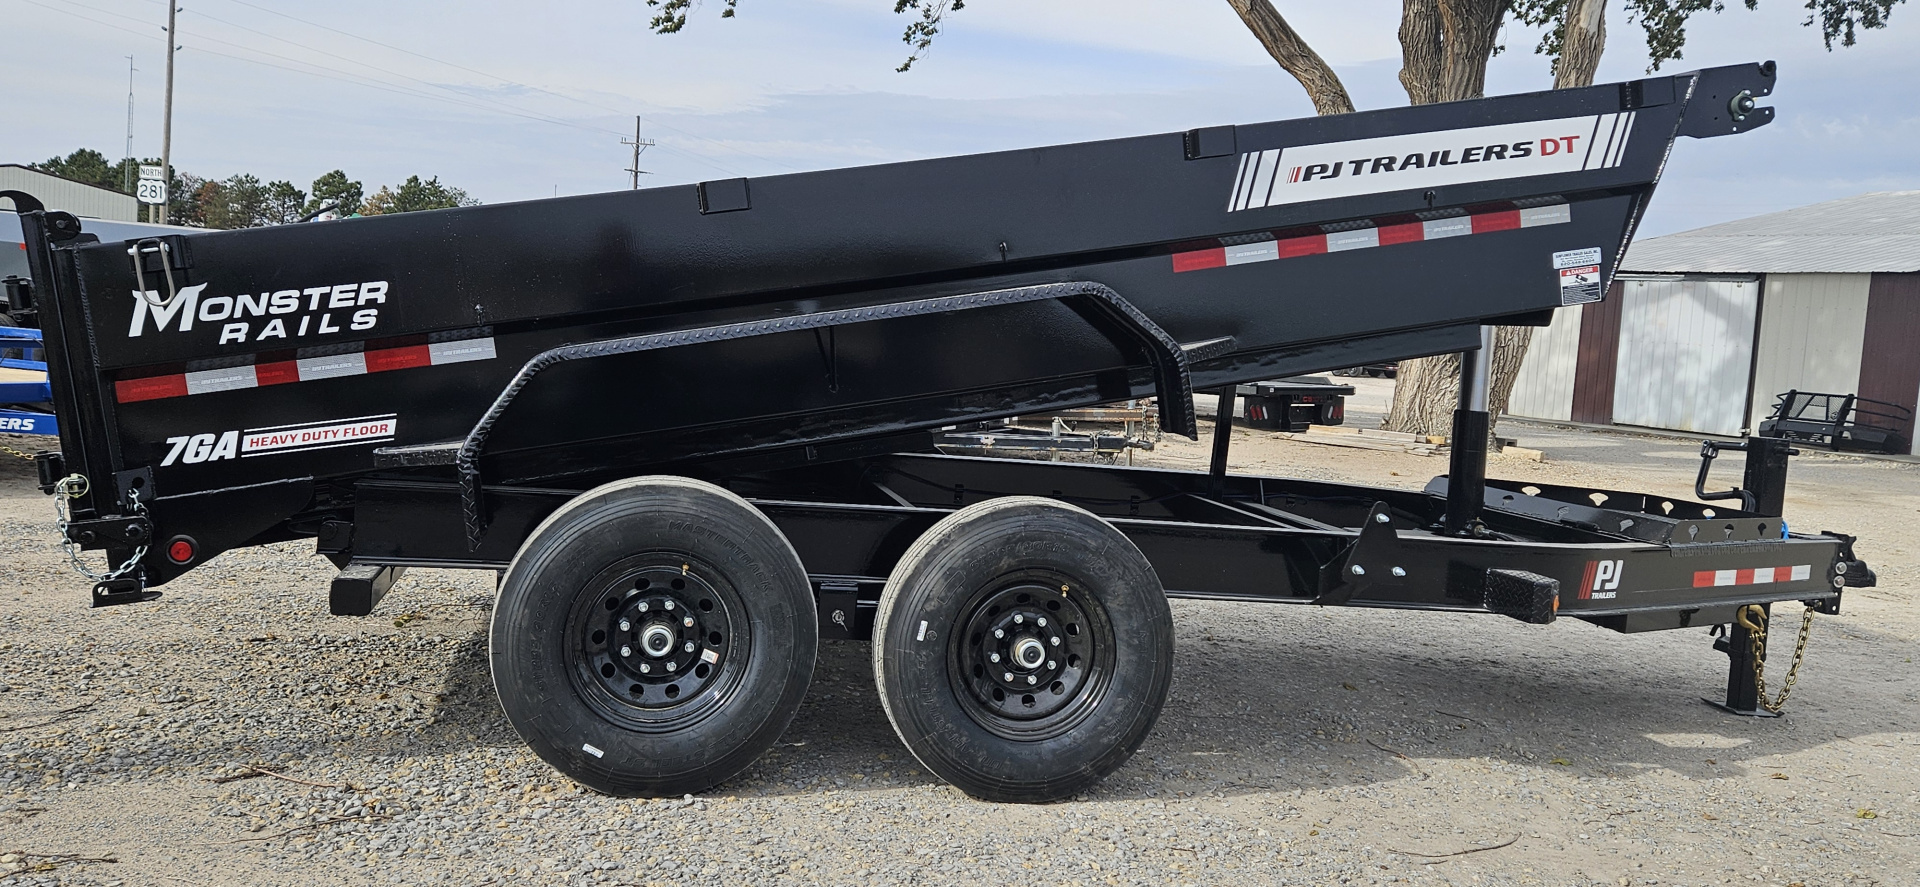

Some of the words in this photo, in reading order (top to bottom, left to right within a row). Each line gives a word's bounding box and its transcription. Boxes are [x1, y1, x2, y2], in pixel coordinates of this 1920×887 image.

[140, 167, 163, 177] NORTH
[1302, 160, 1343, 182] PJ
[1348, 140, 1534, 177] TRAILERS
[1540, 135, 1581, 157] DT
[139, 183, 163, 199] 281
[127, 281, 389, 338] MONSTER
[218, 308, 379, 346] RAILS
[160, 430, 240, 467] 7GA
[249, 432, 299, 448] HEAVY
[301, 428, 341, 443] DUTY
[342, 422, 389, 439] FLOOR
[1593, 559, 1624, 591] PJ
[1591, 591, 1617, 600] TRAILERS
